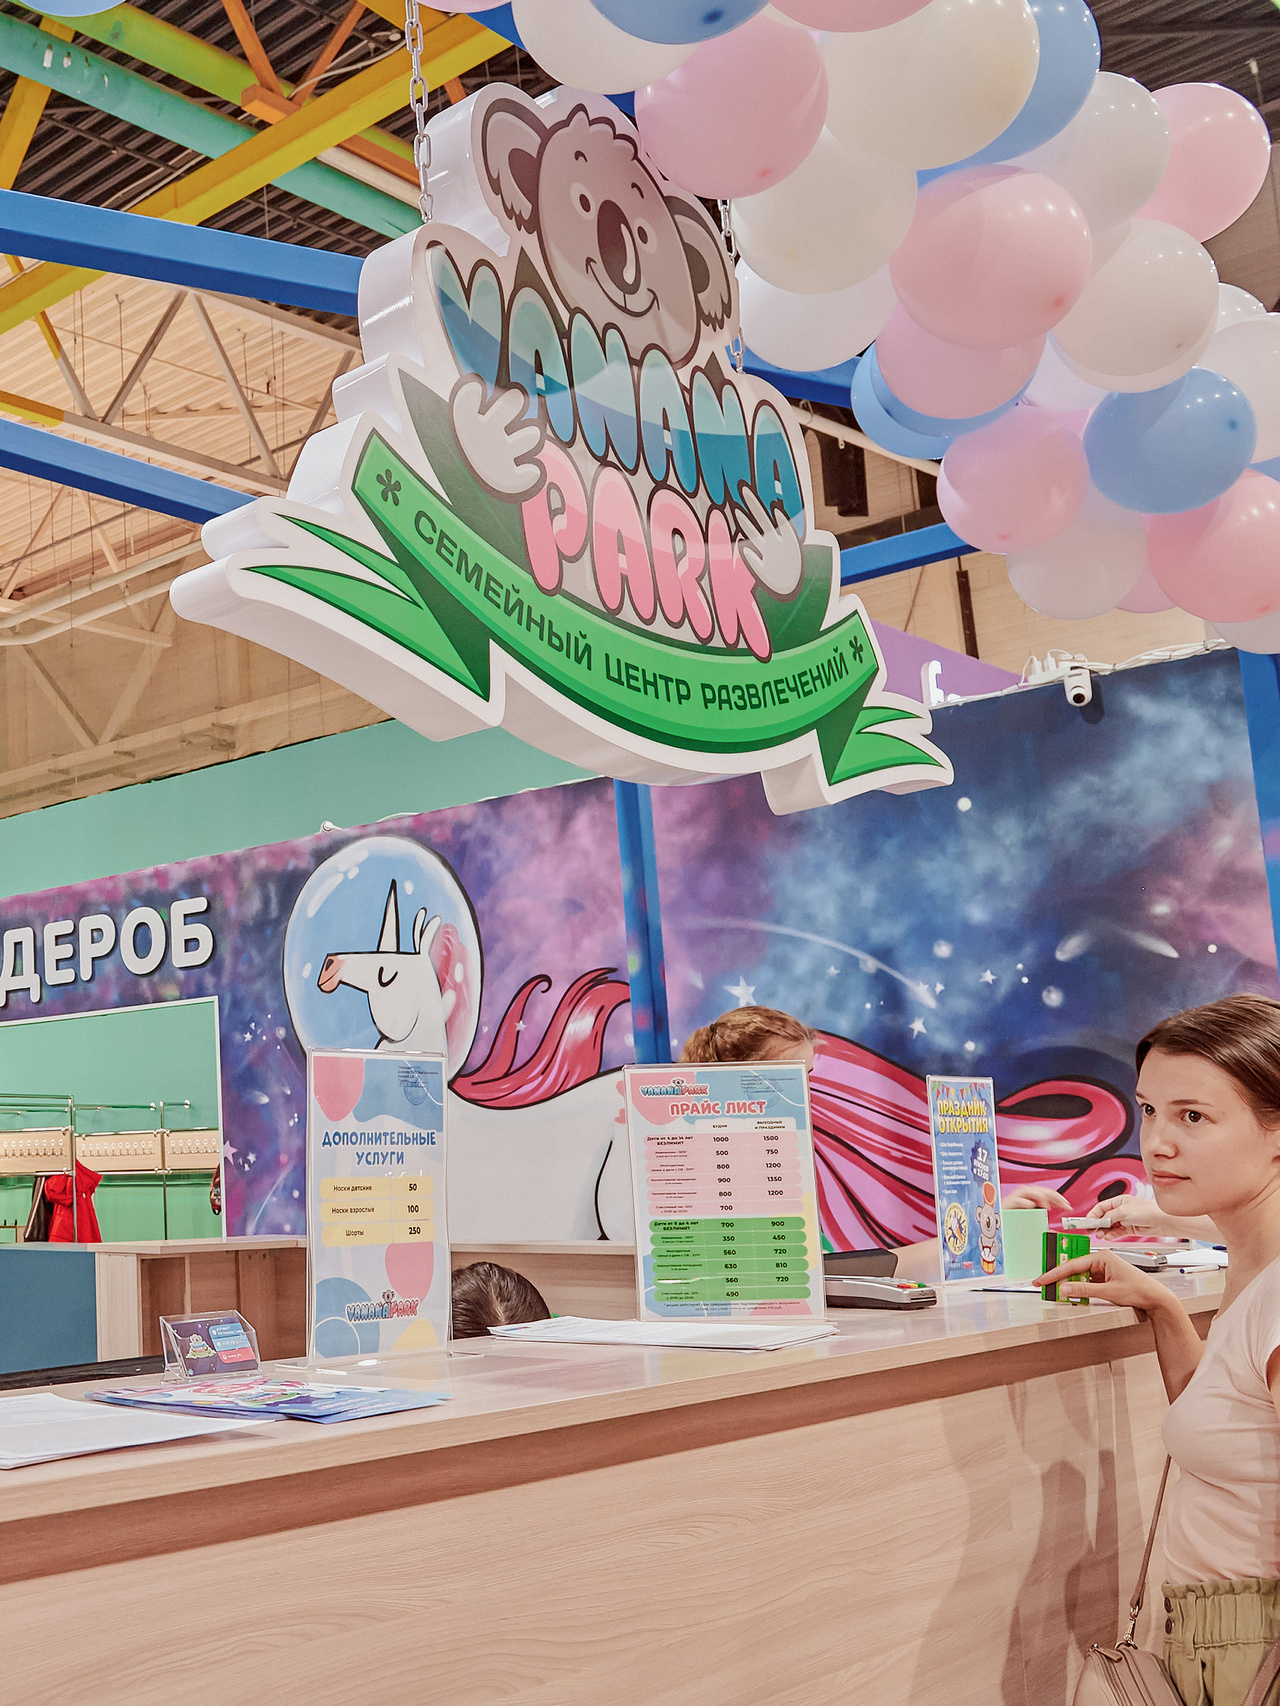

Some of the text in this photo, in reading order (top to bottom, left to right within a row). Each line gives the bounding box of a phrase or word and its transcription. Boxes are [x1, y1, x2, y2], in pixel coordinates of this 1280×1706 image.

[520, 438, 772, 663] PARK
[414, 510, 849, 710] СЕМЕЙНЫЙ ЦЕНТР РАЗВЛЕЧЕНИЙ
[671, 1100, 766, 1115] ПРАЙС ЛИСТ
[937, 1100, 987, 1117] ПРАЗДНИК
[939, 1117, 988, 1134] ОТКРЫТИЯ
[322, 1131, 436, 1147] ДОПОЛНИТЕЛЬНЫЕ
[356, 1151, 404, 1165] УСЛУГИ
[977, 1147, 988, 1163] 17
[408, 1183, 417, 1191] 50
[407, 1205, 419, 1213] 100
[408, 1227, 421, 1235] 250
[389, 1300, 418, 1318] PARK
